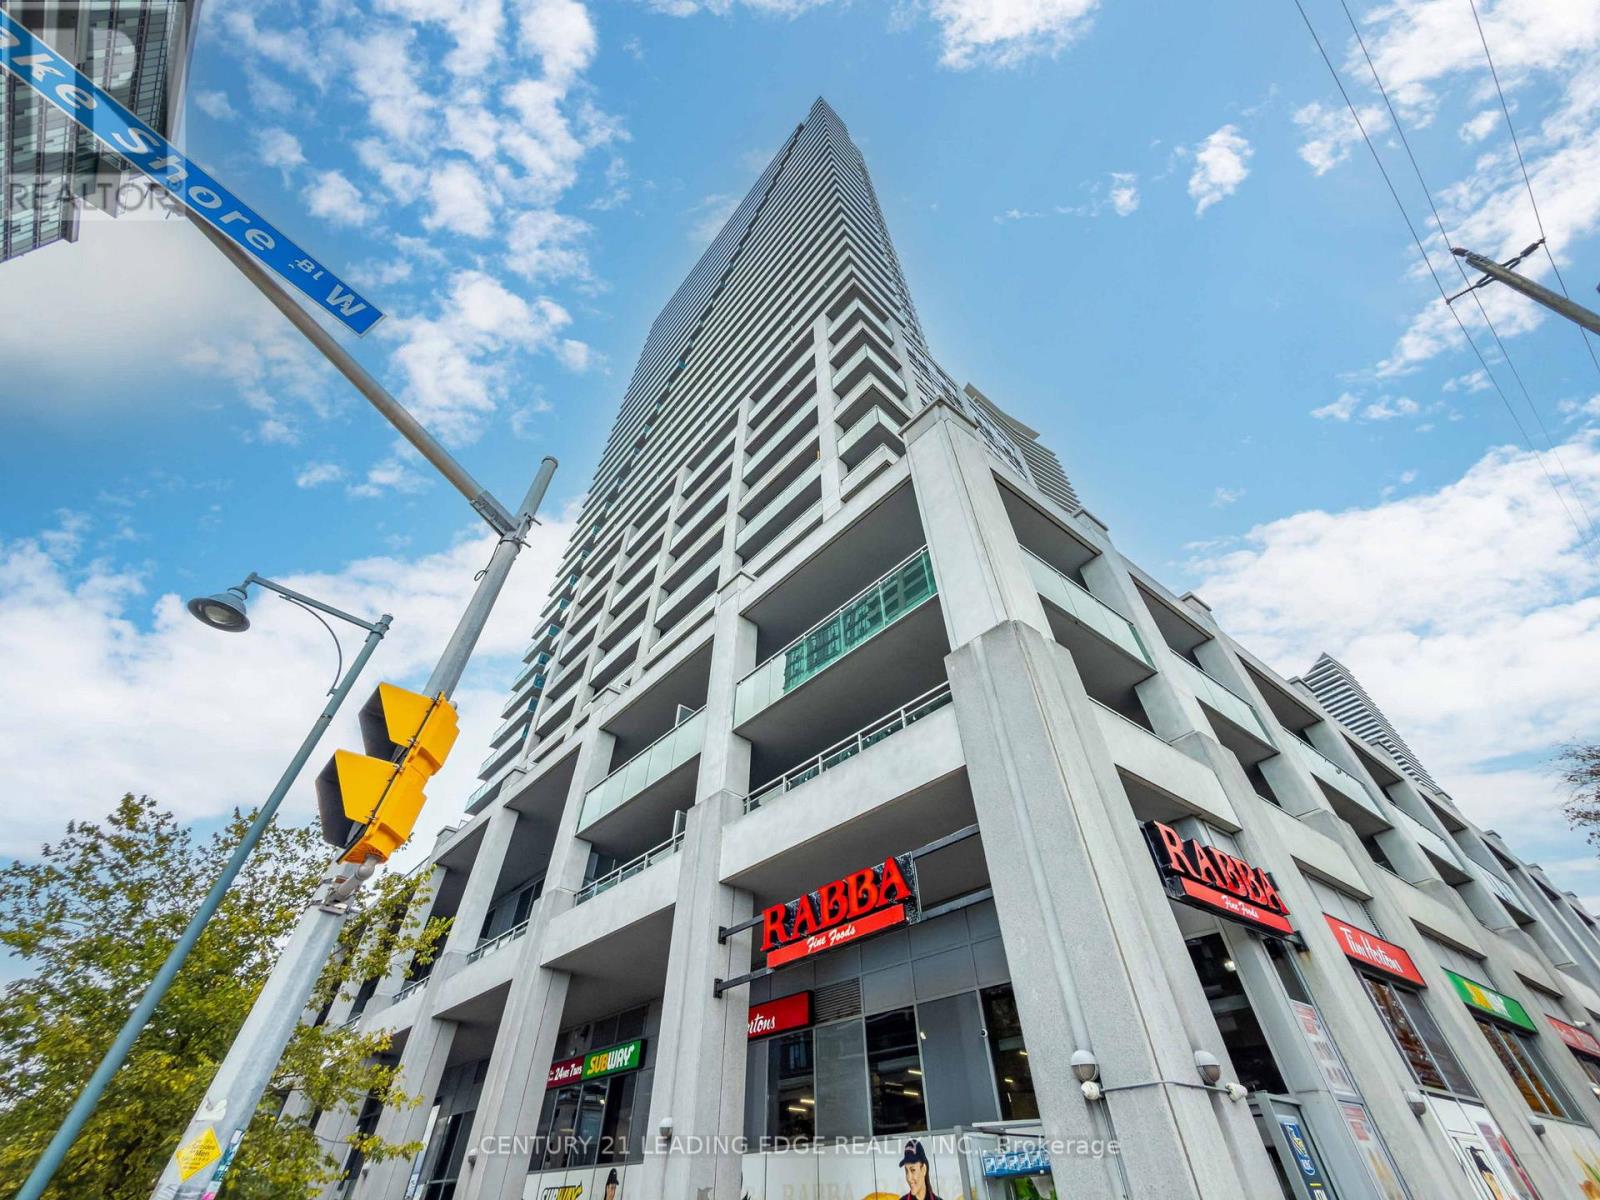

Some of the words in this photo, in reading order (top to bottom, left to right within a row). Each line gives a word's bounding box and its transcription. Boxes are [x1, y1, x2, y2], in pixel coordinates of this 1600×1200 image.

[111, 127, 276, 251] Shore
[325, 284, 367, 317] W
[760, 856, 911, 951] RABBA
[1154, 820, 1291, 915] RABBA
[806, 935, 827, 954] Fine
[828, 924, 857, 946] Foods
[587, 1044, 635, 1075] SUBWAY
